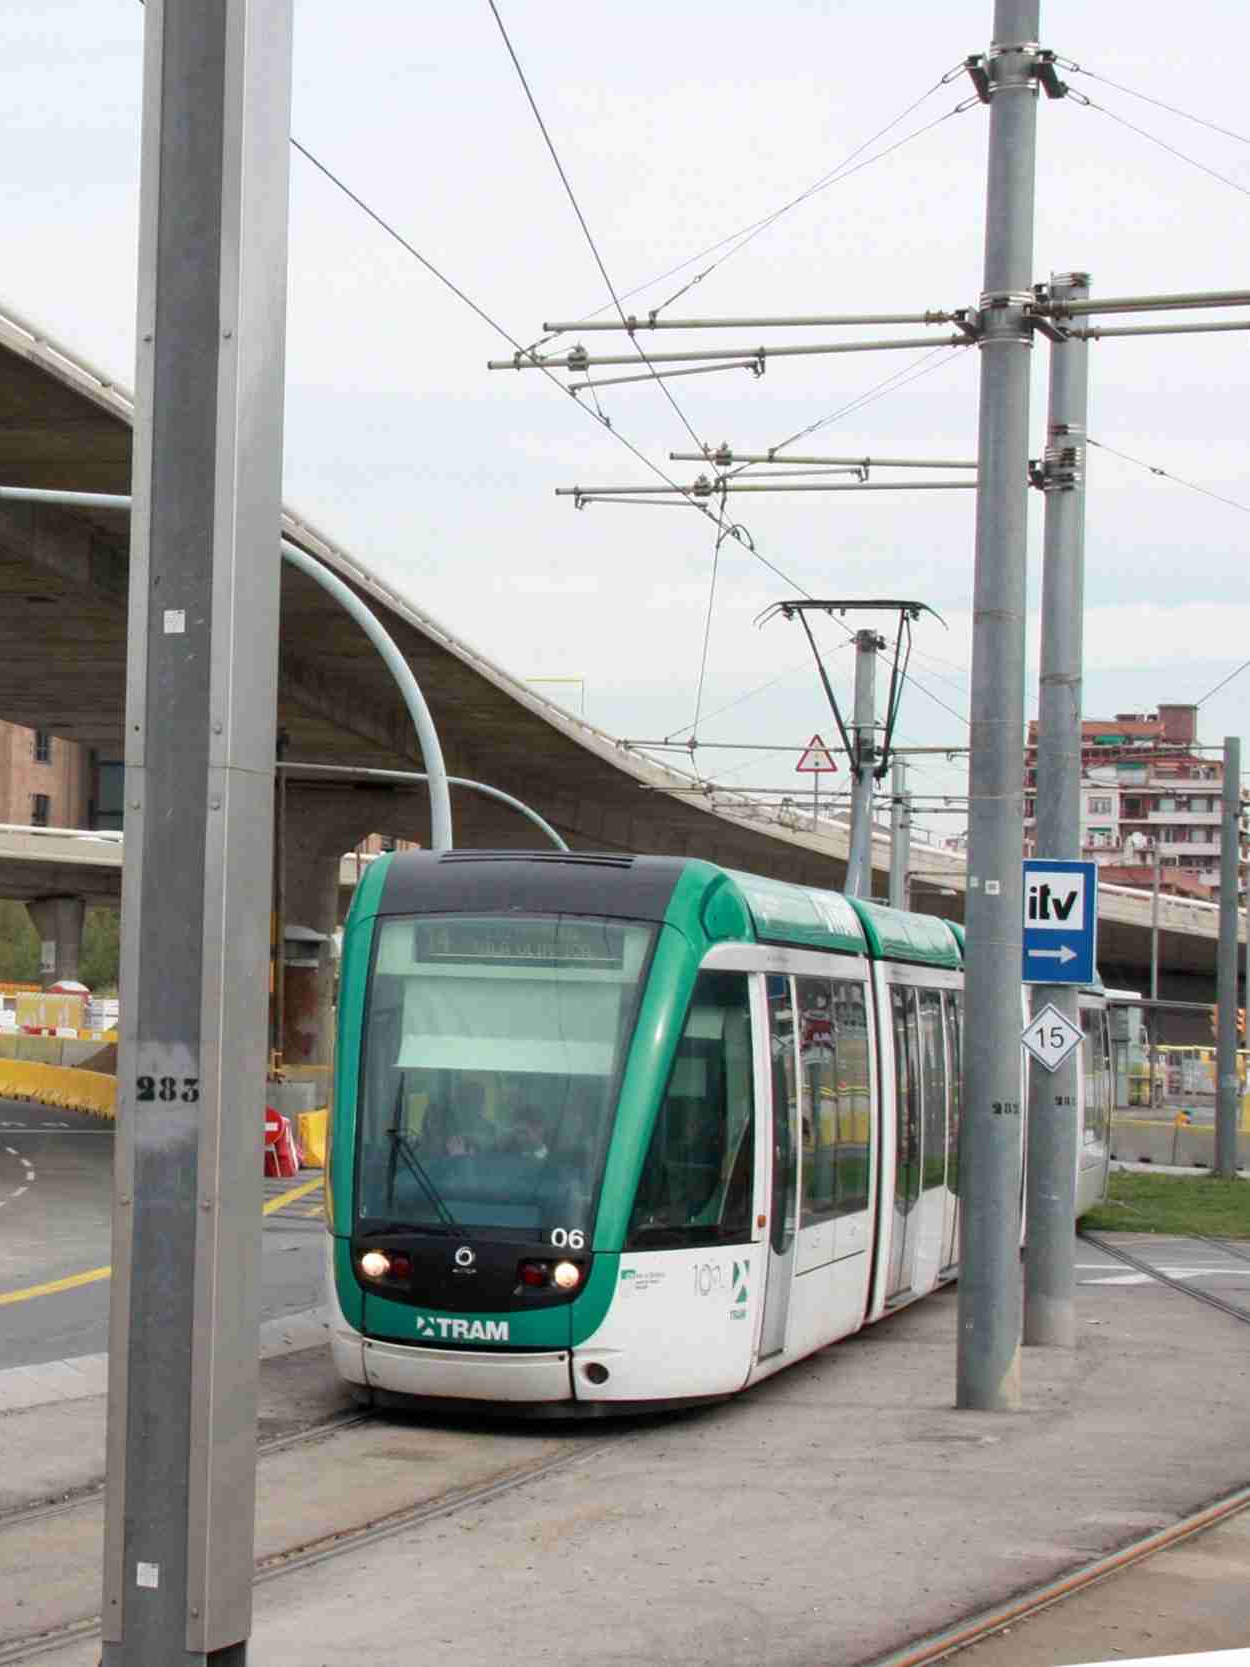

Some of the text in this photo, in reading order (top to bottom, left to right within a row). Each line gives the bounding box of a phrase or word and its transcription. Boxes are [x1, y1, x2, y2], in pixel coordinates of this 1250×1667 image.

[1028, 883, 1078, 921] itv
[1035, 1026, 1065, 1049] 15
[136, 1076, 200, 1103] 283
[550, 1227, 585, 1250] 06
[436, 1317, 510, 1341] TRAM
